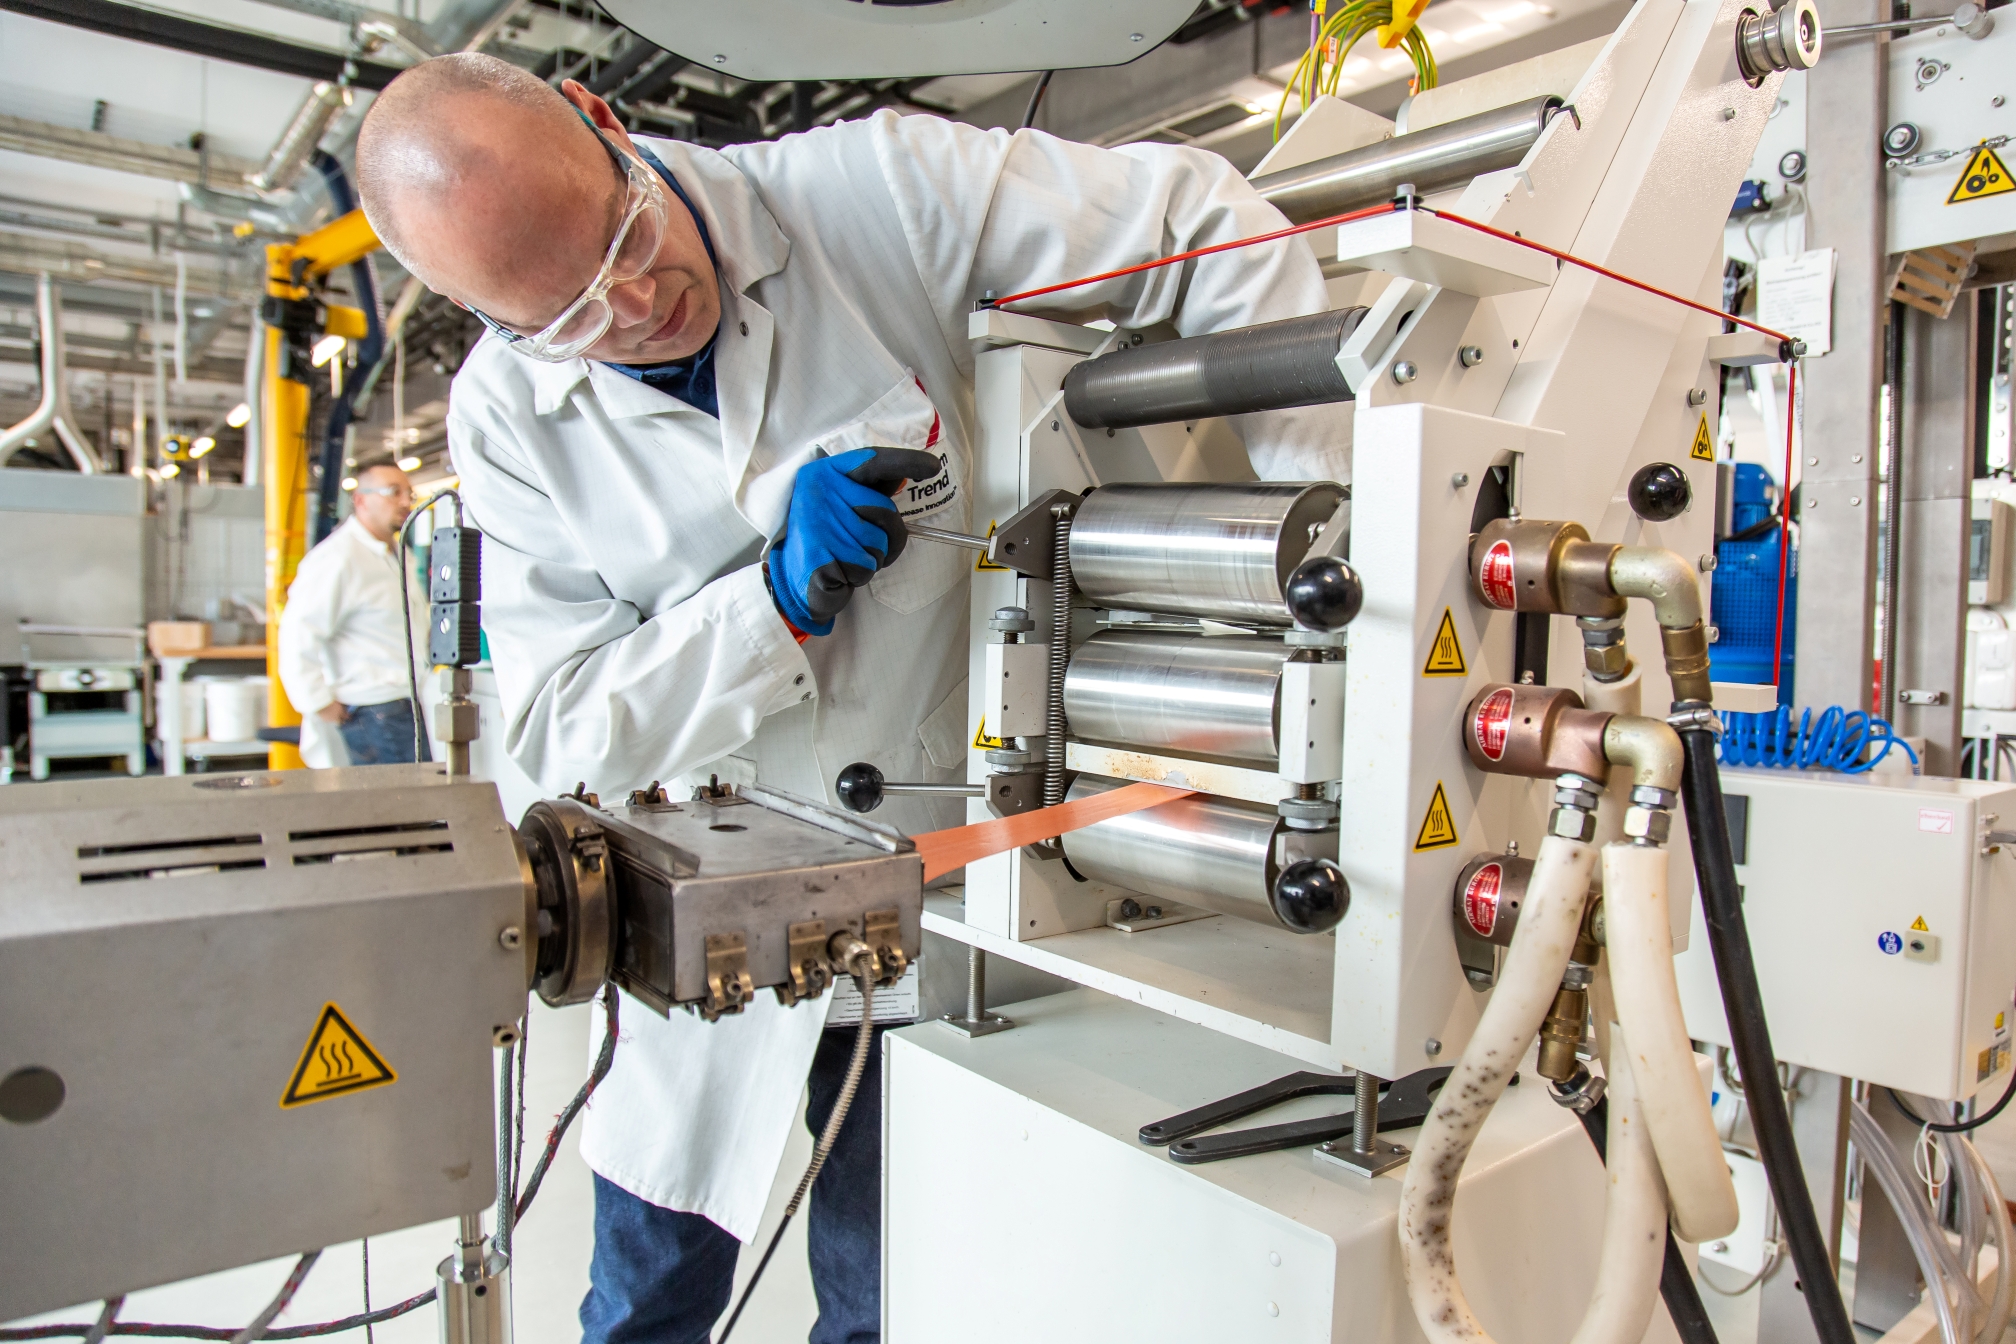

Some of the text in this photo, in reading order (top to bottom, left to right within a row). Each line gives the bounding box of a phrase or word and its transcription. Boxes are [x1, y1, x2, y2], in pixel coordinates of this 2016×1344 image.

[907, 469, 949, 502] Trend
[900, 507, 924, 517] elease
[1483, 553, 1496, 580] EUROPE
[1477, 695, 1496, 748] AIRMAT EUROPE
[1466, 870, 1485, 924] AIRMAT EUROPE
